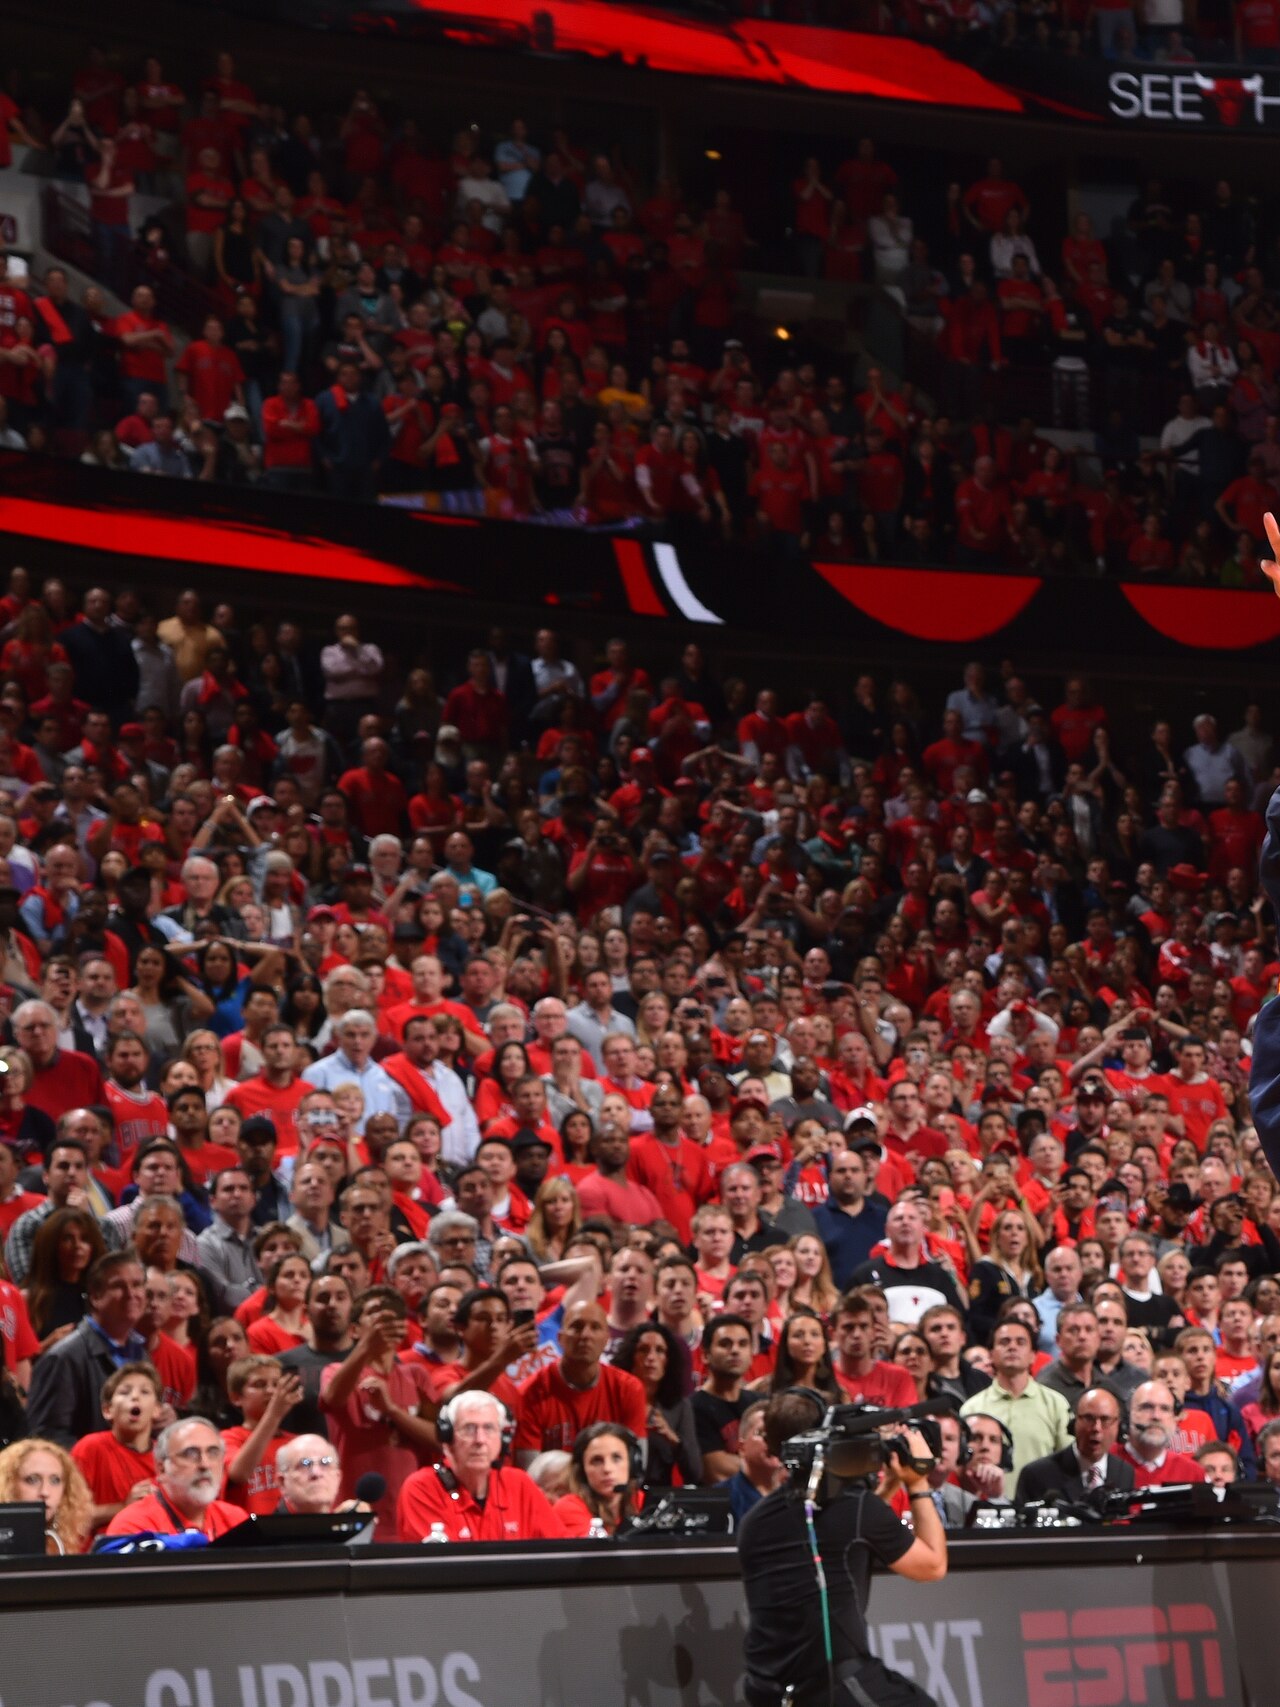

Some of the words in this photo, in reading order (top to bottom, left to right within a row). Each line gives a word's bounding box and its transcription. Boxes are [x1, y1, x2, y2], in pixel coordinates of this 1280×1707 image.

[1108, 72, 1203, 121] SEE
[867, 1619, 984, 1707] EXT
[1020, 1603, 1225, 1707] ESPN
